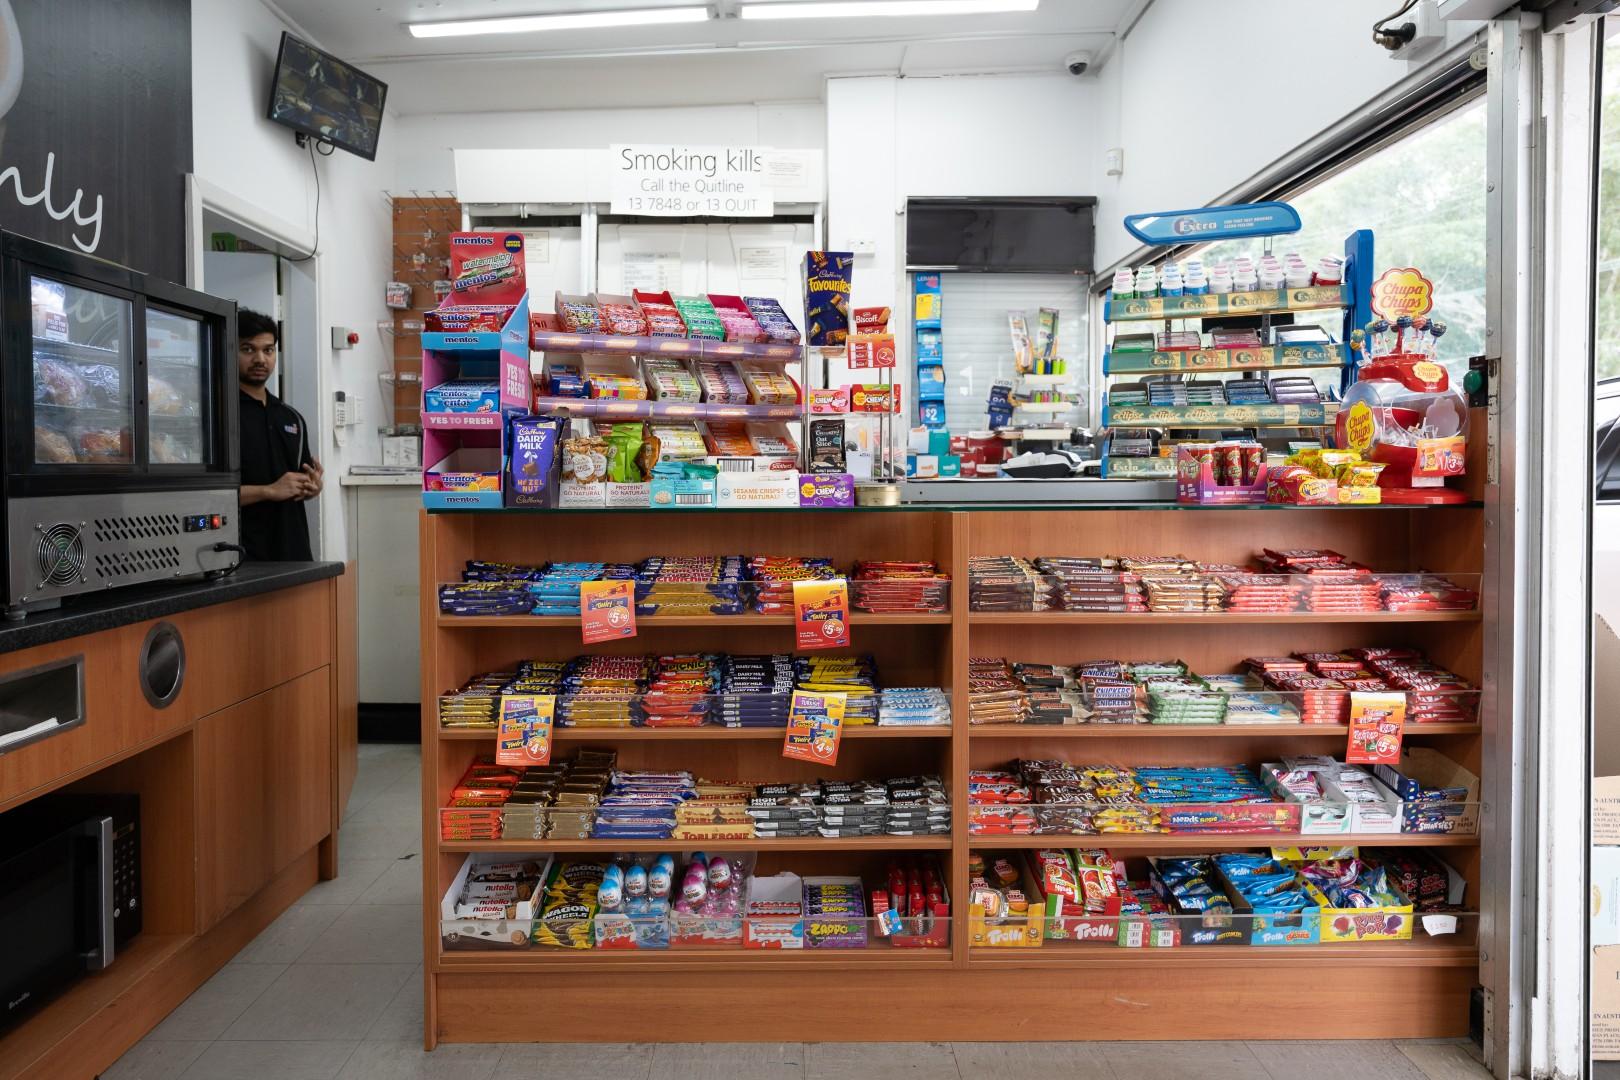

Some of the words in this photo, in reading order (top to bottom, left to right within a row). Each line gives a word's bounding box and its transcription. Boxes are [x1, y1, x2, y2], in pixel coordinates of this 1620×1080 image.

[621, 148, 717, 177] Smoking
[726, 149, 761, 172] kills
[640, 178, 664, 192] Call
[669, 180, 690, 193] the
[694, 179, 745, 194] Quitline
[628, 197, 643, 210] 13
[647, 198, 682, 211] 7848
[686, 200, 700, 211] or
[705, 198, 720, 211] 13
[724, 199, 759, 212] QUIT
[454, 236, 494, 245] mentos
[455, 271, 498, 289] mentos
[807, 275, 852, 294] Favourites
[1383, 283, 1423, 299] Chupa
[1380, 294, 1422, 309] Chups
[855, 315, 878, 323] Biscoff
[506, 363, 518, 378] YES
[506, 380, 526, 399] FRESH
[430, 417, 448, 425] YES
[449, 417, 462, 425] TO
[463, 417, 494, 425] FRESH
[925, 407, 937, 421] $2
[1349, 411, 1370, 429] Chupa
[517, 435, 547, 443] DAIRY
[1349, 424, 1371, 443] Chups
[519, 442, 543, 450] MILK
[522, 485, 540, 493] NUT
[815, 487, 835, 495] CHEW
[446, 496, 480, 504] mentos
[682, 832, 750, 840] TOBLERONE
[810, 923, 848, 935] ZAPPO
[987, 928, 1024, 944] Trolli
[1074, 923, 1114, 940] Trolli
[1193, 932, 1215, 942] Trolli
